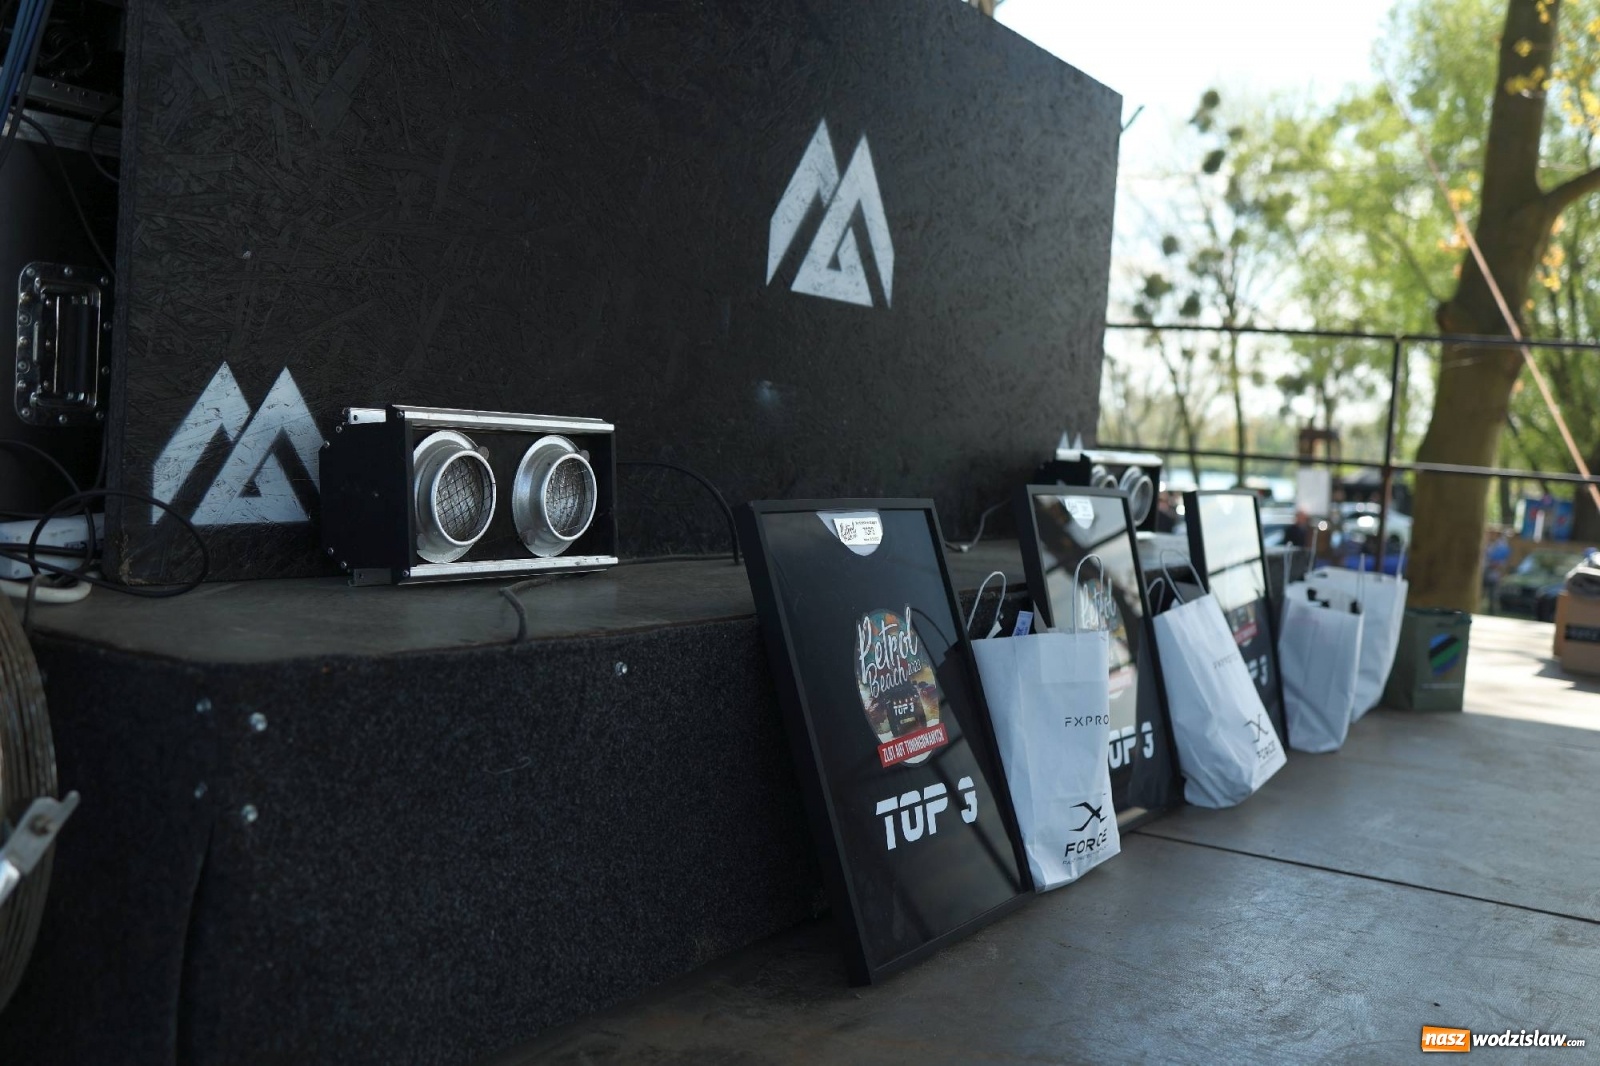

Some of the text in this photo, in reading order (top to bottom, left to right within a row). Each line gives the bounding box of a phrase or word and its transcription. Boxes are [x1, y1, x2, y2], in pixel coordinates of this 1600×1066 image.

[858, 606, 918, 684] Petrol
[866, 655, 908, 698] Beach
[893, 702, 915, 716] TOP 3
[1064, 714, 1109, 728] FXPRO
[1108, 720, 1155, 770] OP 3
[875, 776, 978, 851] TOP 3
[1064, 828, 1108, 858] FORCE
